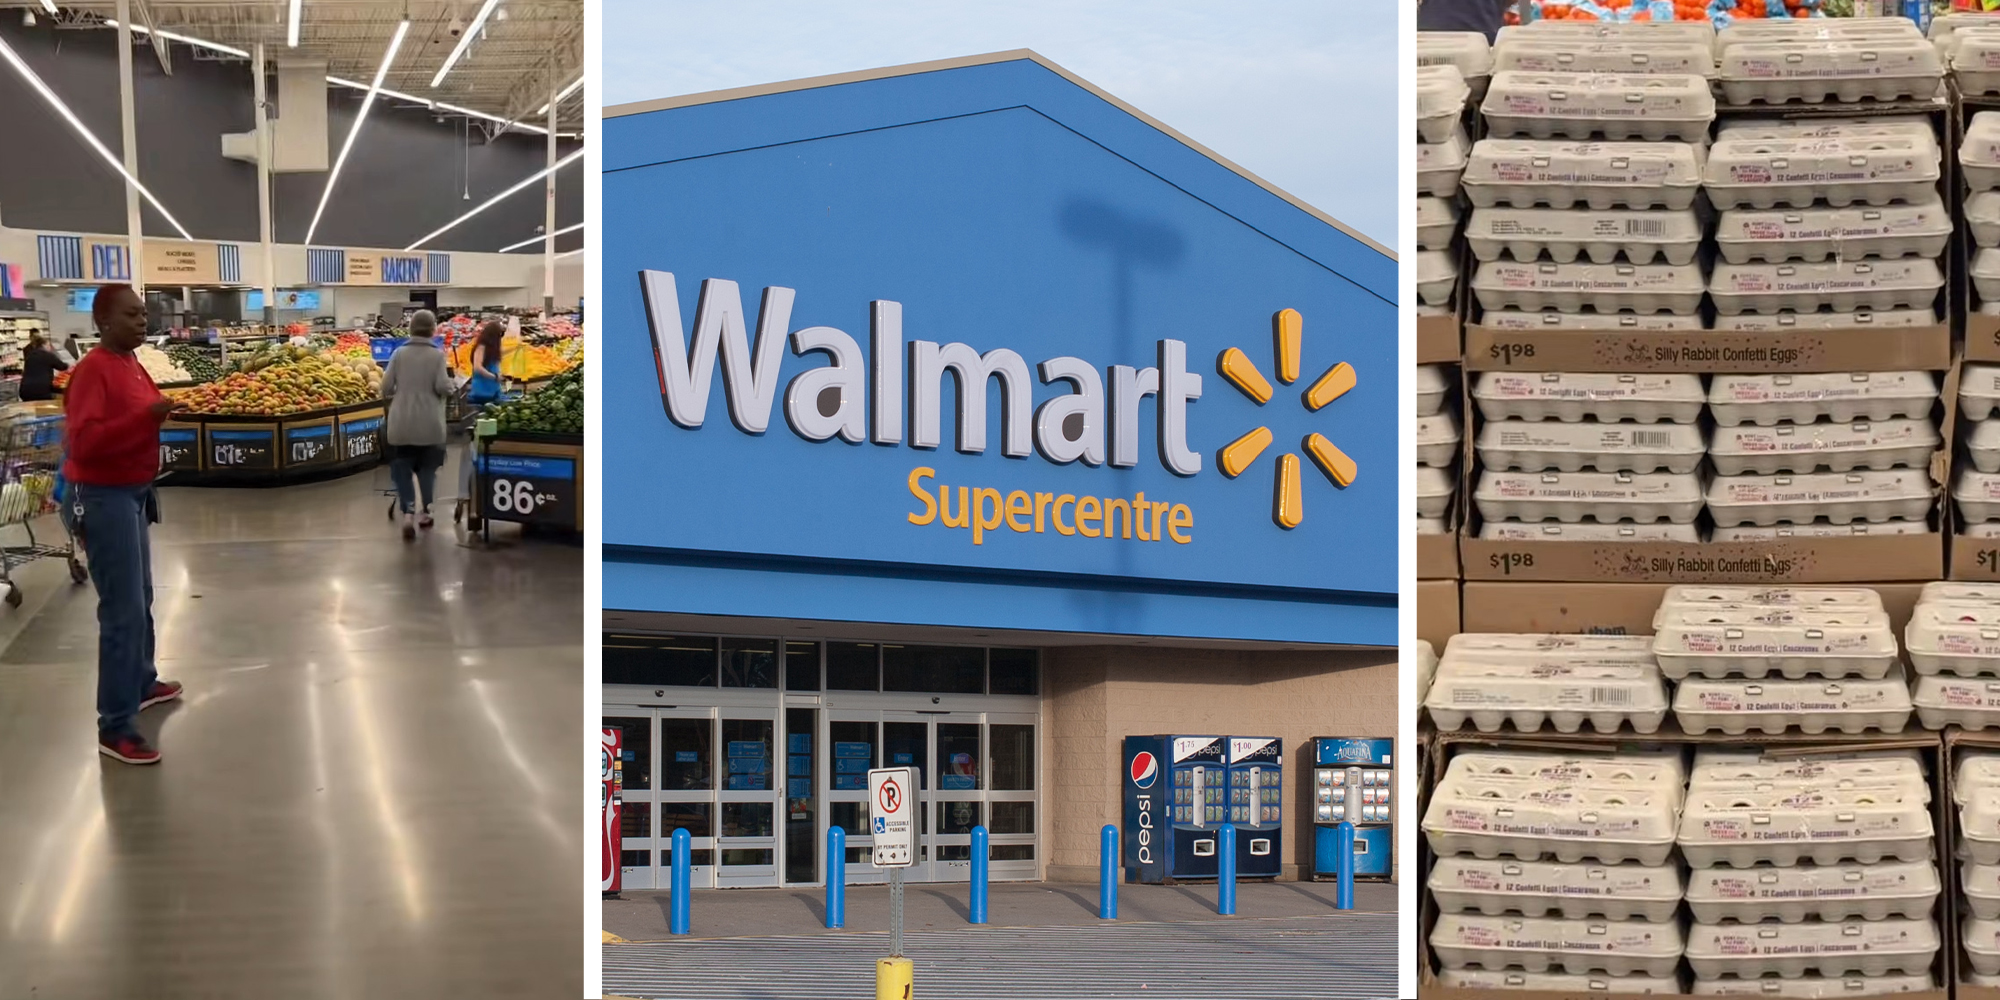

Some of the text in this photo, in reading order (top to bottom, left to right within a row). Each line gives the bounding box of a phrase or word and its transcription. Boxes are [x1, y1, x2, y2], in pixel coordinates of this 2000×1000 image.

[1777, 174, 1785, 182] 12
[381, 256, 423, 283] BAKERY
[1777, 282, 1785, 290] 12
[1655, 347, 1798, 363] Silly Rabbit Confetti Eggs
[638, 269, 1203, 476] Walmart
[908, 467, 1194, 545] Supercentre
[1651, 558, 1791, 575] Silly Rabbit Confetti Eggs
[1233, 740, 1252, 753] $1.00
[1337, 747, 1373, 761] AQUAFINA
[1137, 794, 1153, 864] pepsi
[1494, 824, 1501, 832] 12
[1506, 883, 1514, 891] 12
[1761, 889, 1769, 897] 12
[1507, 939, 1515, 947] 12
[1764, 946, 1772, 954] 12
